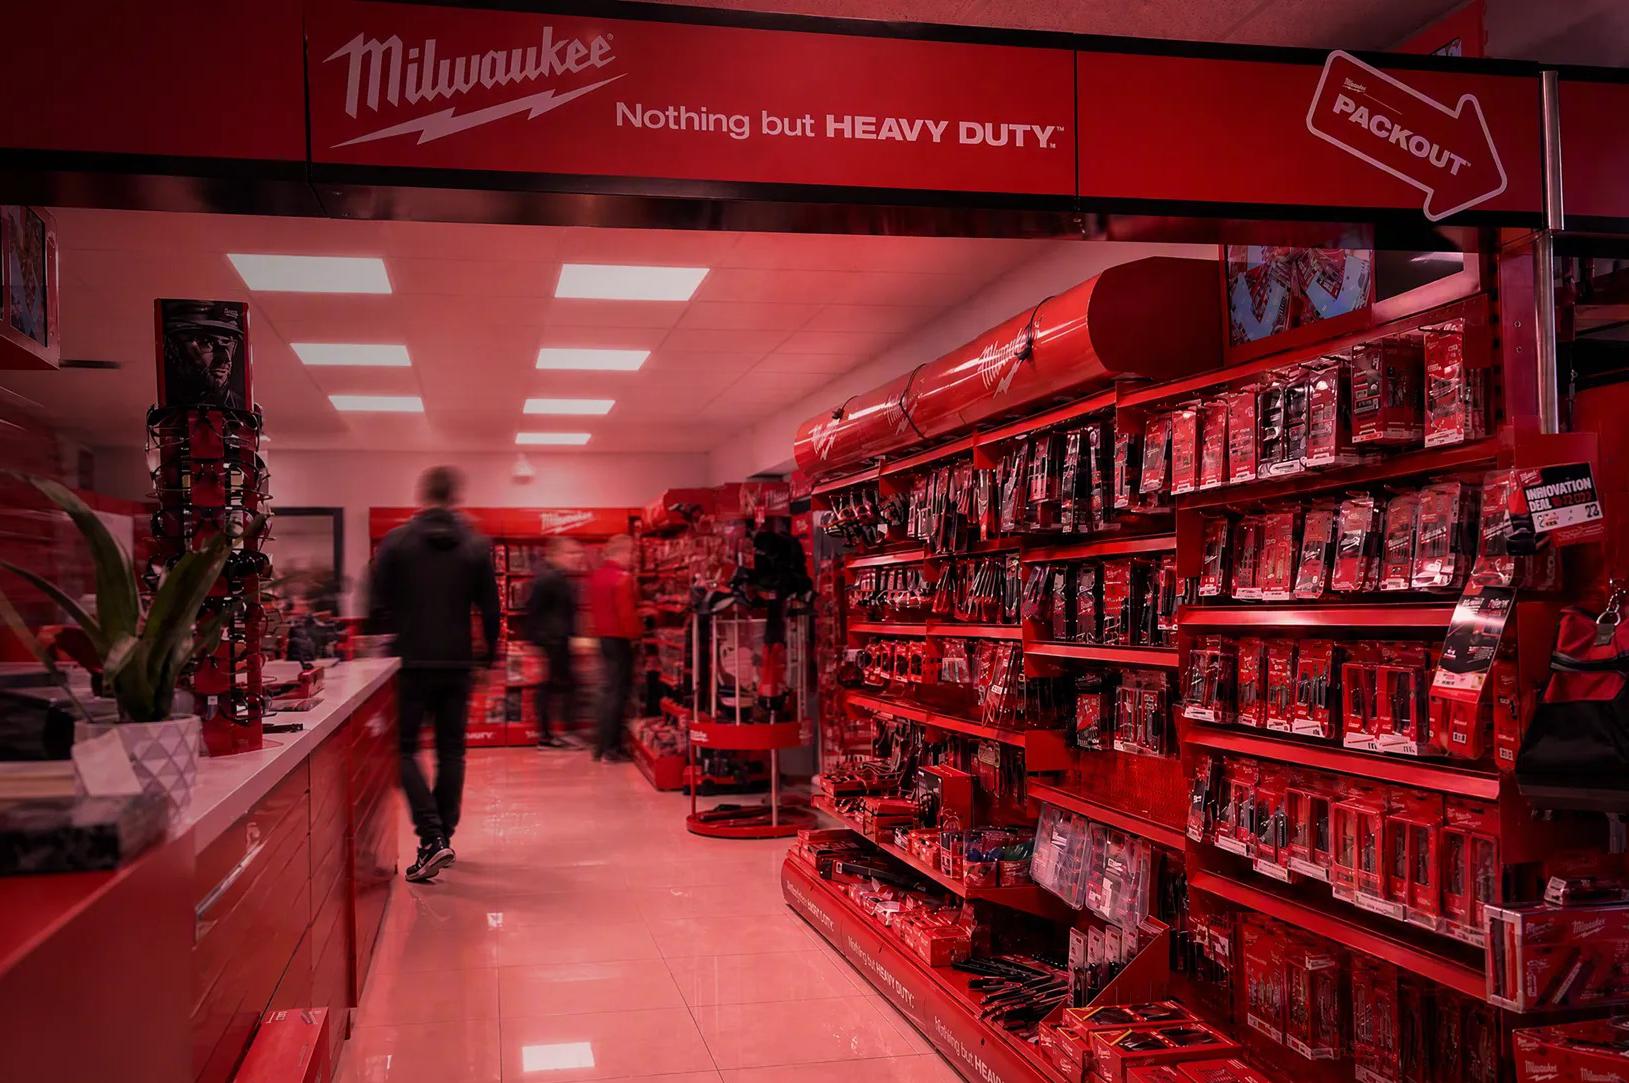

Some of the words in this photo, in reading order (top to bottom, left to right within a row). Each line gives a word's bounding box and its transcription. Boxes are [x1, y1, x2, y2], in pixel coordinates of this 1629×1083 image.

[322, 26, 616, 119] Milwaukee
[615, 102, 750, 139] Nothing
[761, 110, 815, 137] but
[826, 114, 949, 143] HEAVY
[875, 961, 896, 989] HEAVY
[960, 1042, 974, 1067] but
